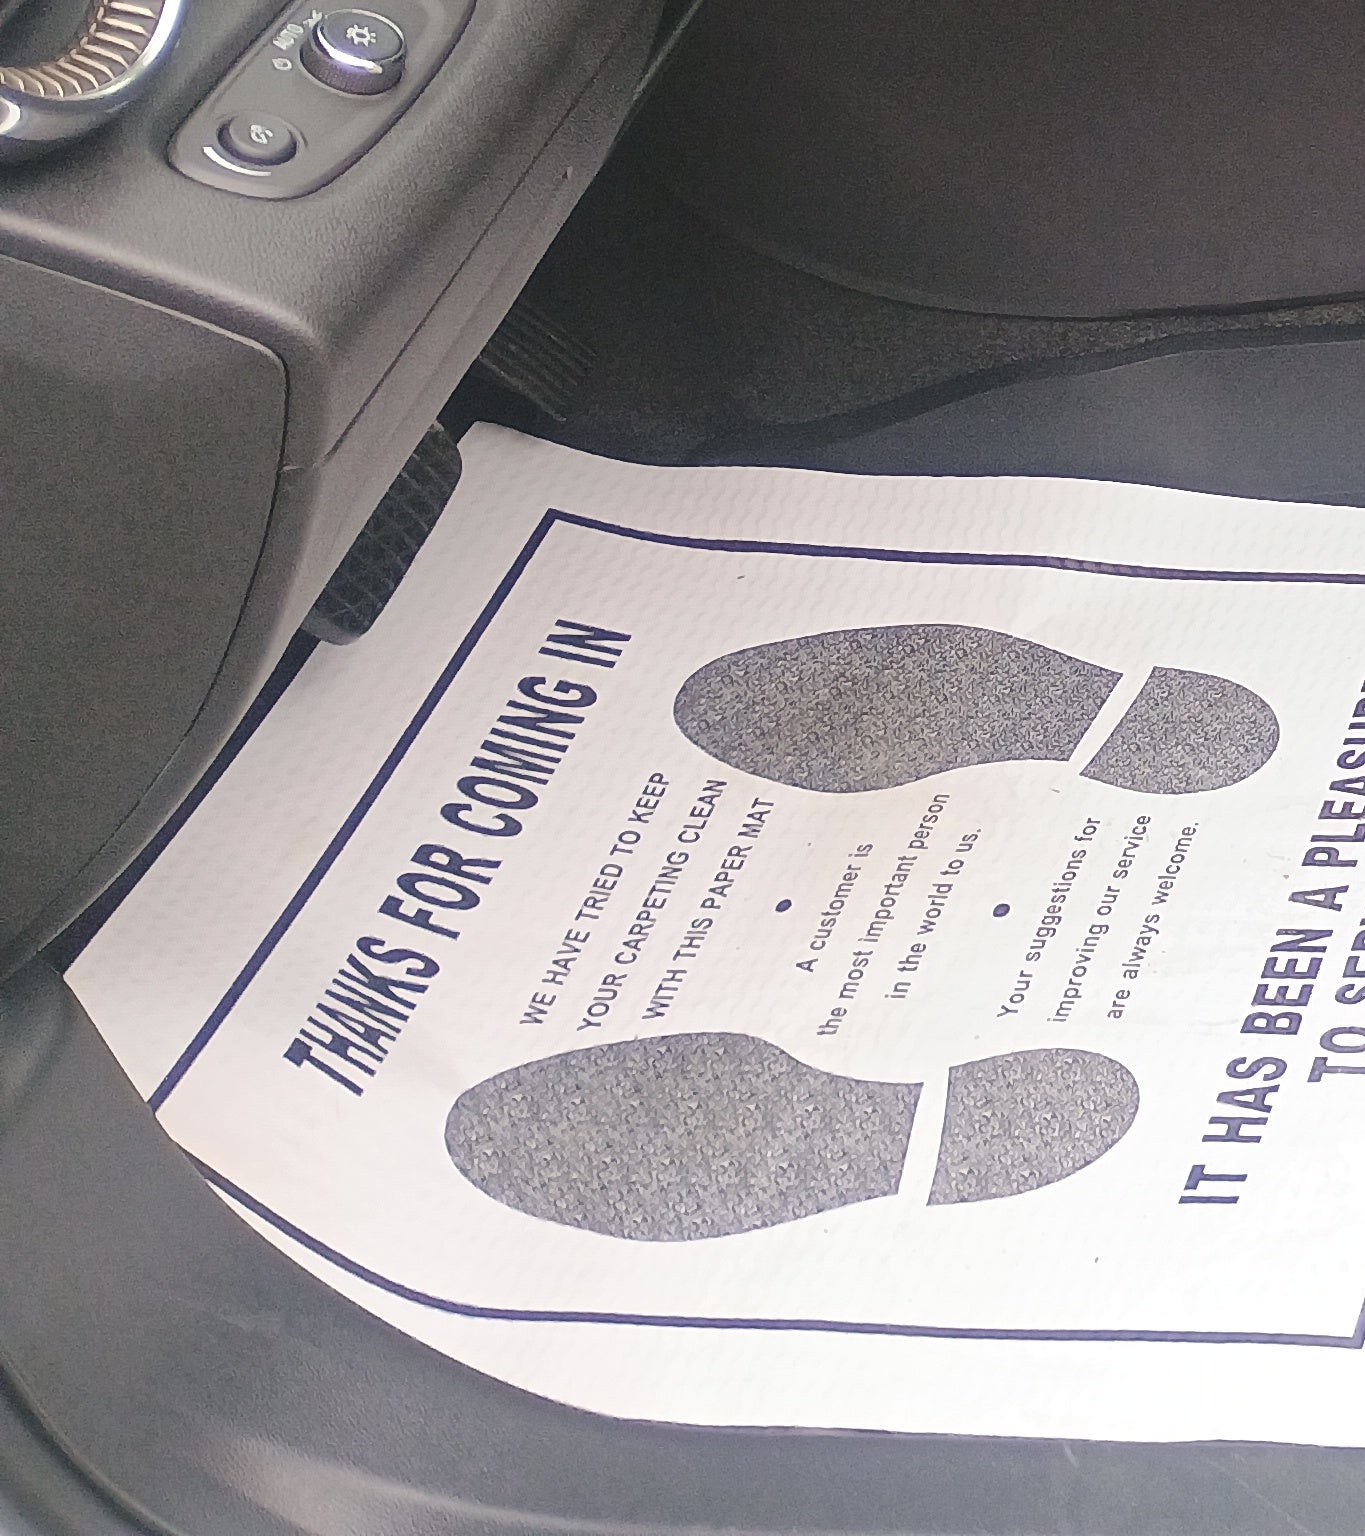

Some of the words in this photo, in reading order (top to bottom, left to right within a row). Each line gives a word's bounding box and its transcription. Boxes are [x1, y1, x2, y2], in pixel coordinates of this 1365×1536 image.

[538, 619, 632, 668] IN
[440, 676, 598, 838] COMING
[378, 843, 503, 941] FOR
[940, 859, 965, 876] to
[955, 828, 982, 853] us.
[519, 992, 557, 1024] WE
[541, 929, 590, 985] HAVE
[575, 863, 623, 921] TRIED
[609, 830, 641, 856] TO
[628, 772, 670, 823] KEEP
[576, 973, 628, 1031] YOUR
[614, 851, 690, 964] CARPETING
[677, 779, 727, 843] CLEAN
[641, 969, 687, 1019] WITH
[673, 917, 713, 961] THIS
[700, 845, 753, 909] PAPER
[738, 797, 774, 839] MAT
[795, 958, 819, 973] A
[810, 864, 861, 951] customer
[848, 843, 873, 858] is
[816, 1007, 848, 1036] the
[839, 950, 874, 999] most
[858, 855, 918, 943] important
[908, 794, 950, 850] person
[917, 883, 953, 935] world
[996, 970, 1033, 1017] Your
[1025, 849, 1087, 962] suggestions
[1074, 817, 1101, 841] for
[1046, 924, 1110, 1022] improving
[1097, 885, 1120, 916] our
[1113, 815, 1151, 879] service
[1107, 989, 1130, 1019] are
[1122, 913, 1160, 979] always
[1152, 822, 1199, 905] welcome.
[1288, 885, 1349, 912] A
[884, 981, 911, 999] in
[897, 942, 926, 972] the
[1240, 928, 1333, 1035] BEEN
[283, 936, 440, 1097] THANKS
[1202, 1056, 1288, 1143] HAS
[1178, 1164, 1248, 1204] IT
